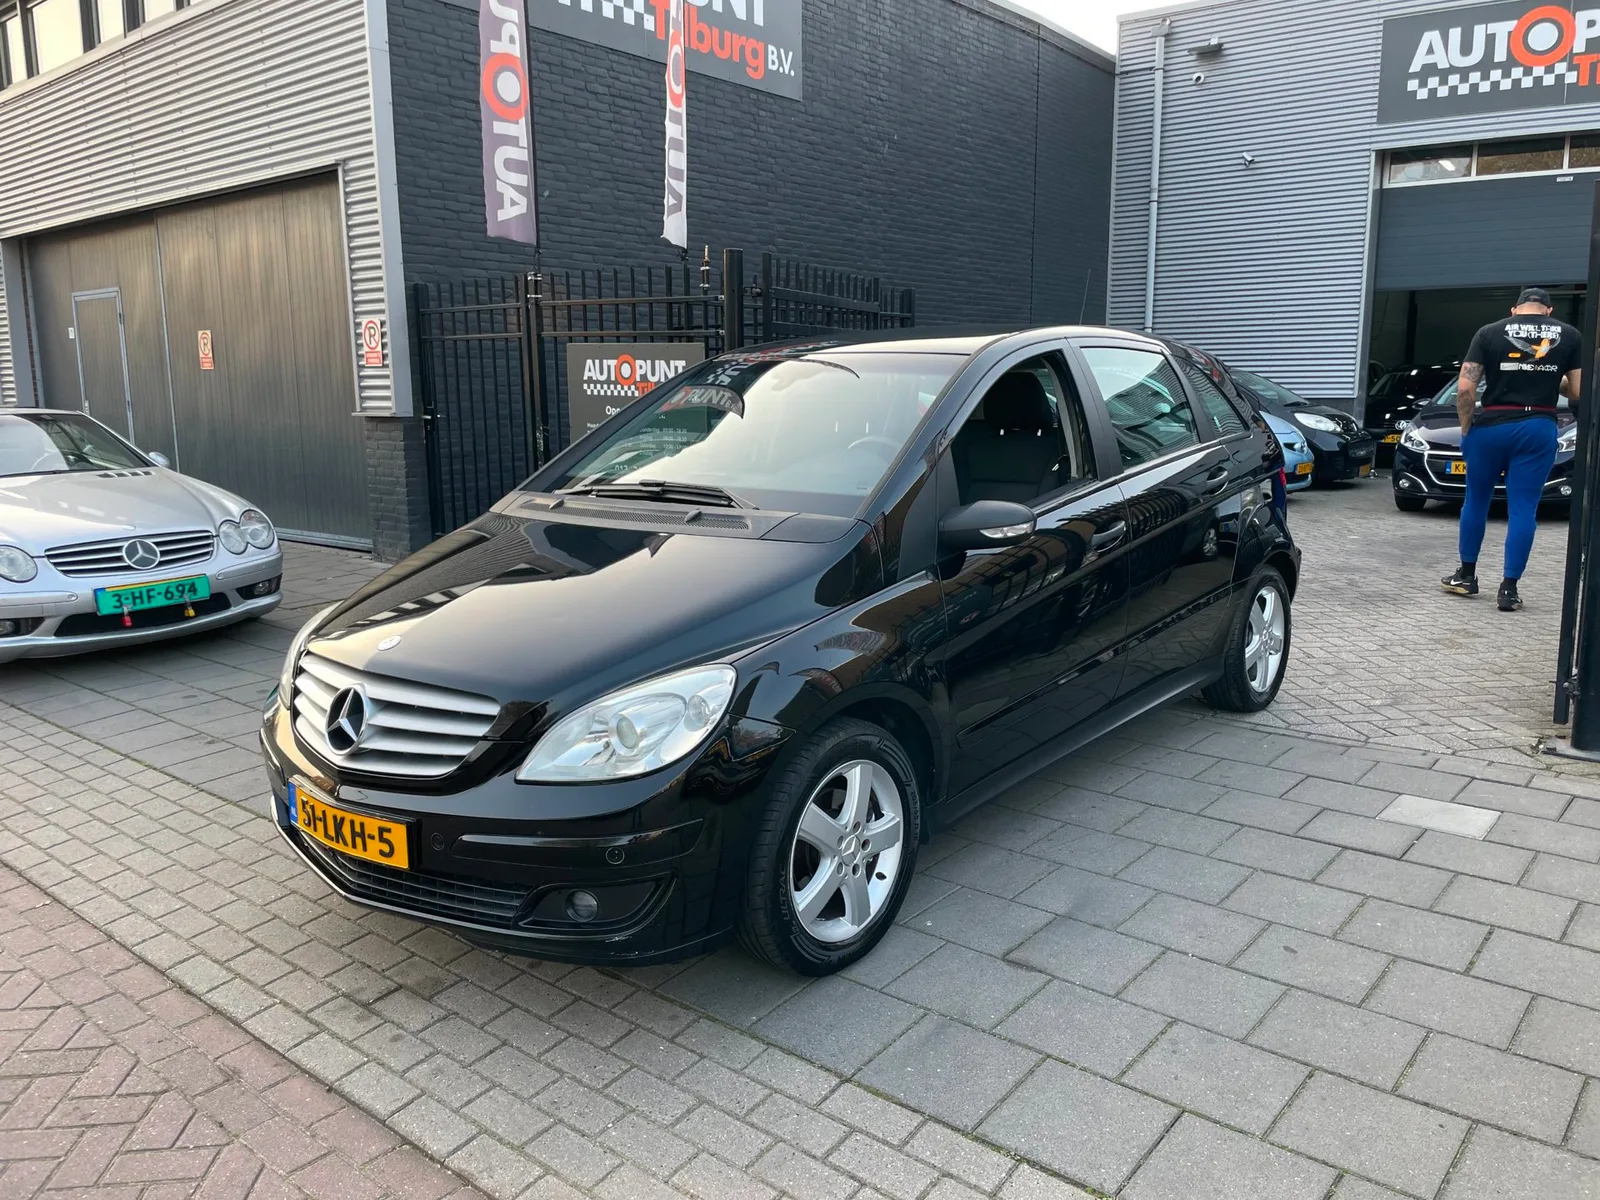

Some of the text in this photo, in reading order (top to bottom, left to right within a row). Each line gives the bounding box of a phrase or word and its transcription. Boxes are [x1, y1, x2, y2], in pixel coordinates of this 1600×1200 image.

[1409, 6, 1600, 72] AUTOP
[768, 44, 795, 76] B.V.
[583, 354, 686, 386] AUTOPUNT
[112, 582, 198, 609] 3-HF-694
[300, 796, 395, 858] 51-LKH-5
